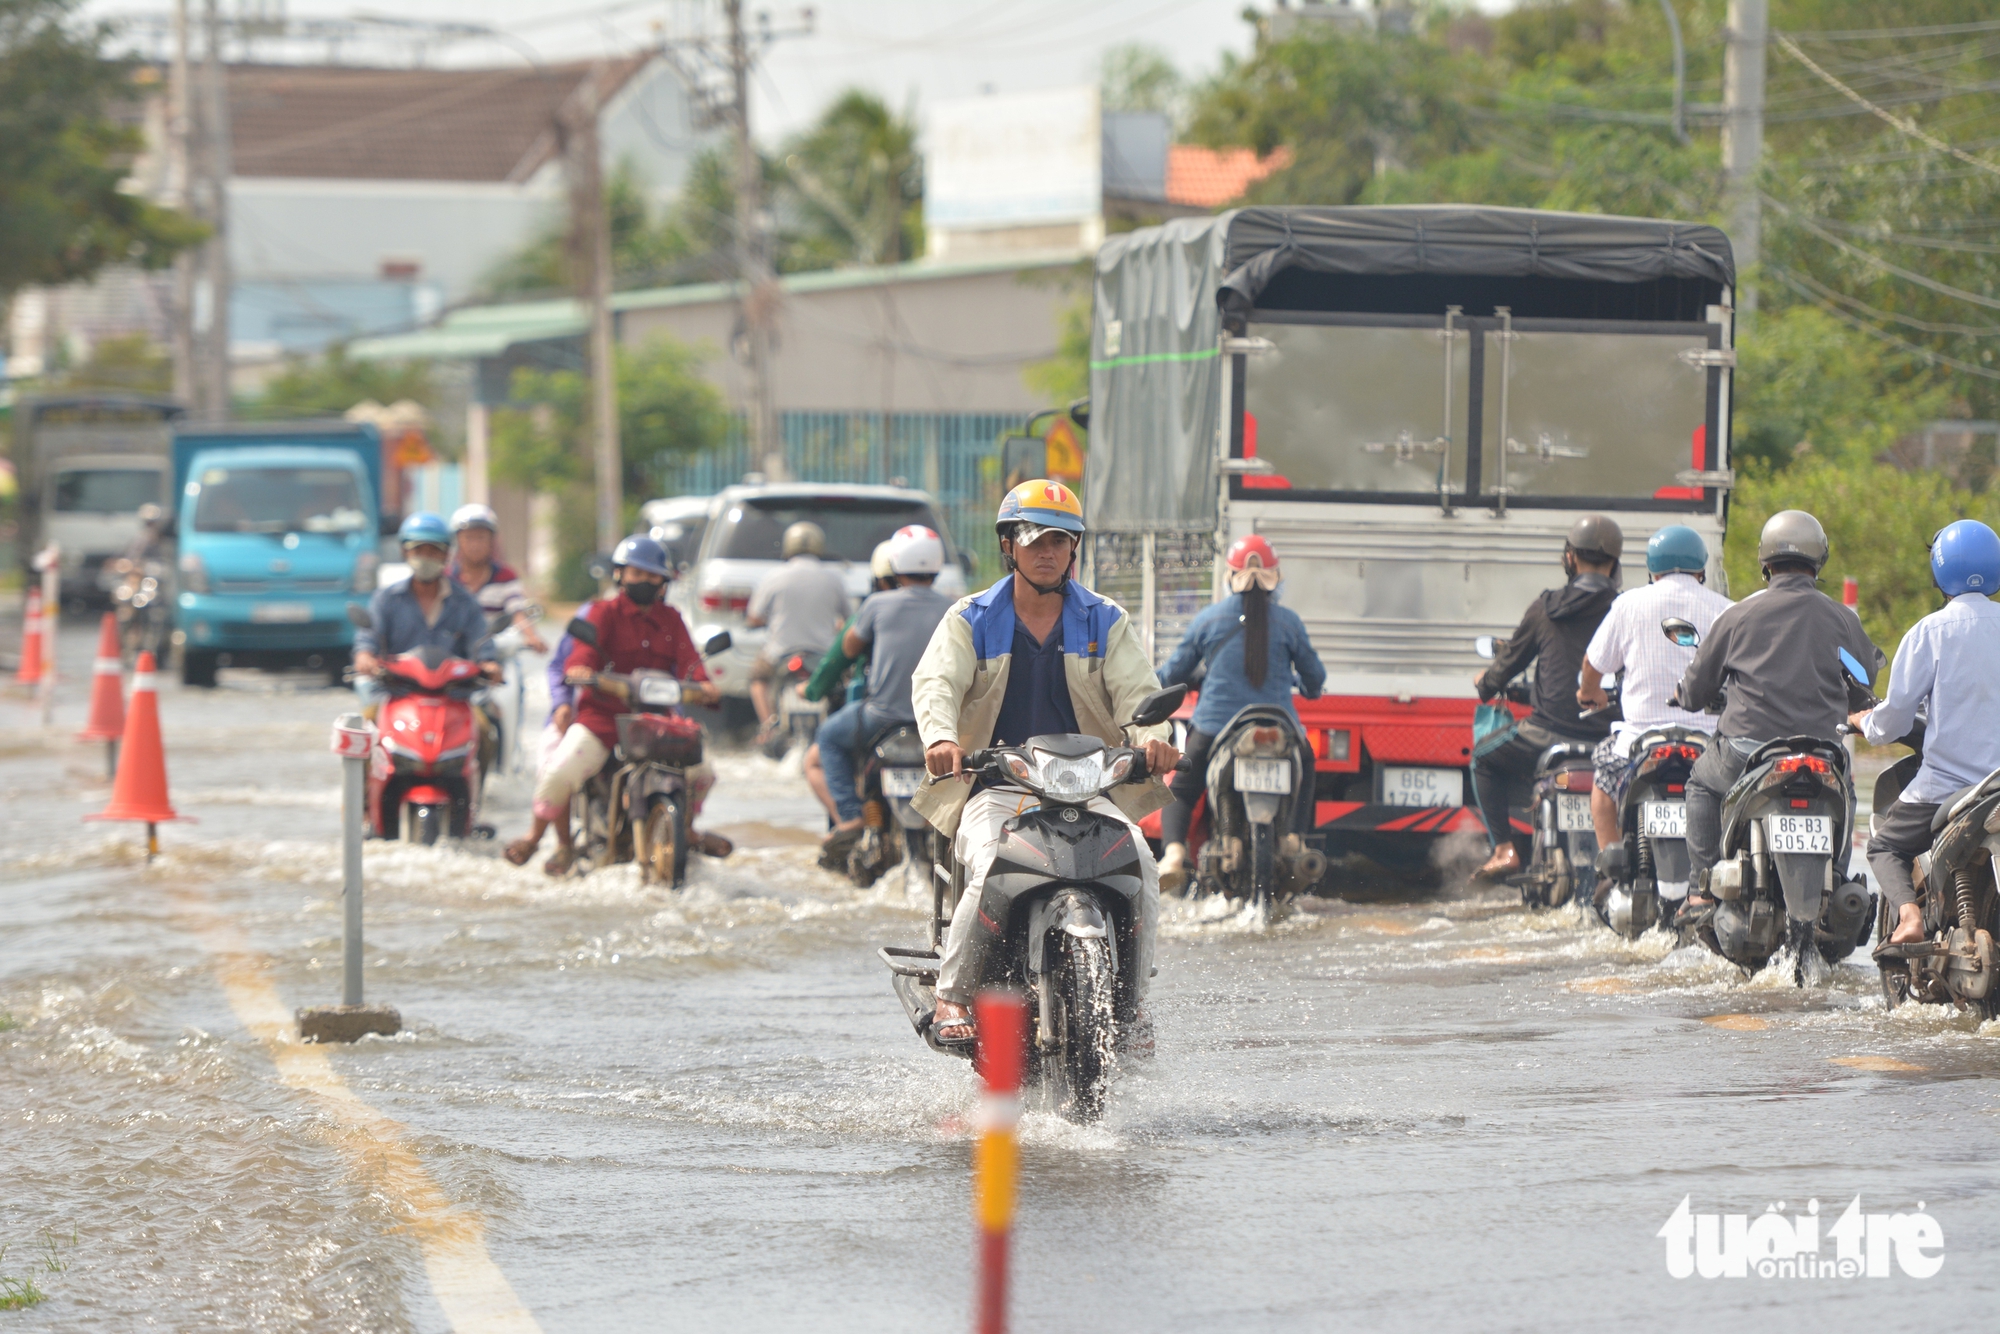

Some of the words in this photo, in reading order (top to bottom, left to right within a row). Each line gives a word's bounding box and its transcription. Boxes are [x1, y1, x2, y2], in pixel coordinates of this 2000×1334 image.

[1401, 767, 1437, 790] 86C
[1566, 813, 1594, 829] 585
[1780, 817, 1823, 833] 86-B3
[1774, 834, 1830, 851] 505.42
